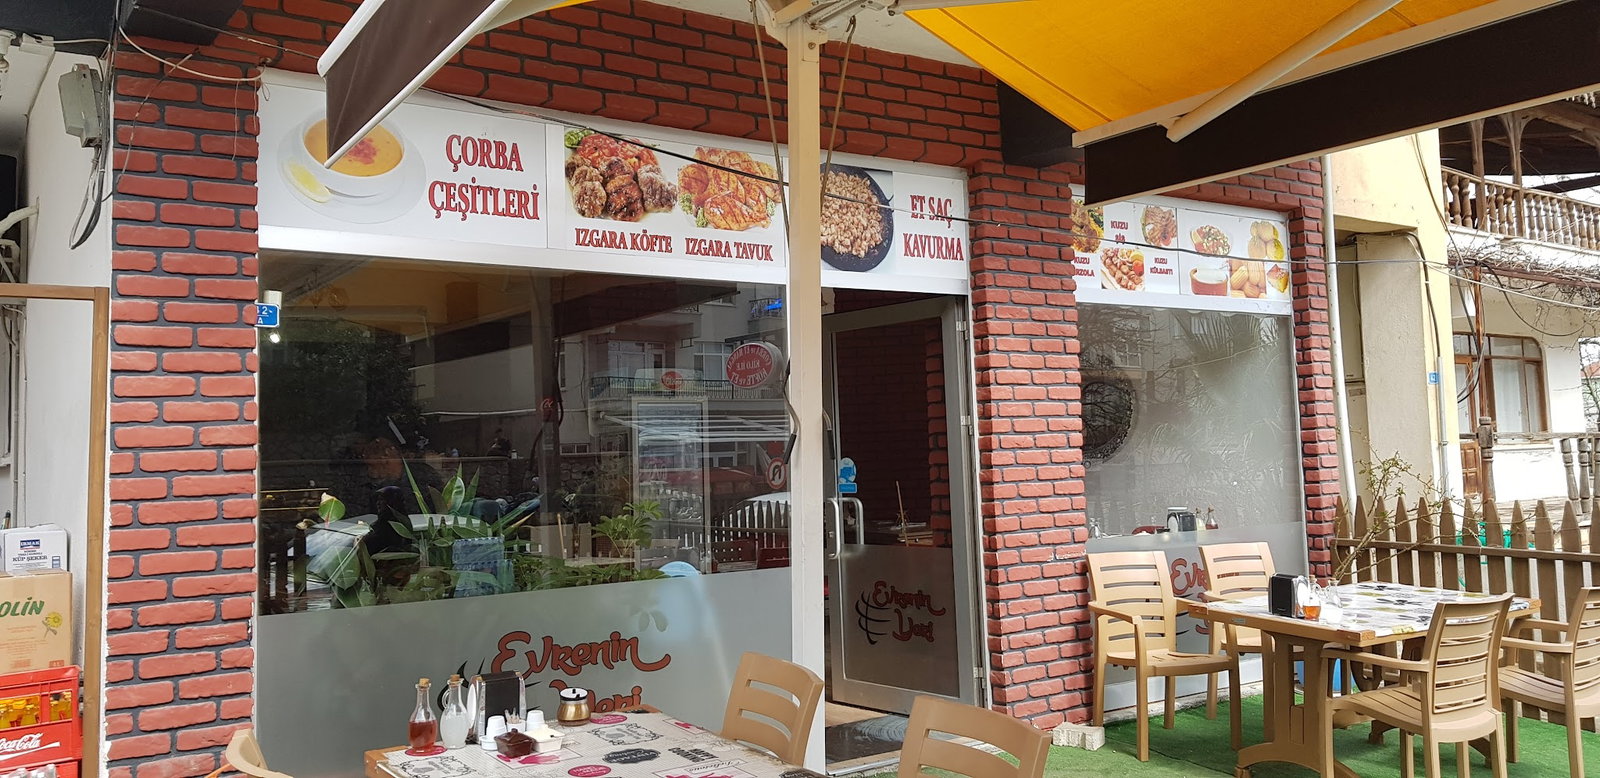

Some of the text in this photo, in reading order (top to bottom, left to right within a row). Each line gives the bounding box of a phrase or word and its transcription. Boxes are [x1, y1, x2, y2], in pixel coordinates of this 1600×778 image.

[445, 134, 524, 172] ÇORBA
[428, 176, 540, 221] ÇEŞİTLERİ
[910, 194, 953, 229] ET SAÇ
[574, 227, 673, 254] IZGARA KÖFTE
[684, 237, 774, 262] IZGARA TAVUK
[902, 232, 965, 261] KAVURMA
